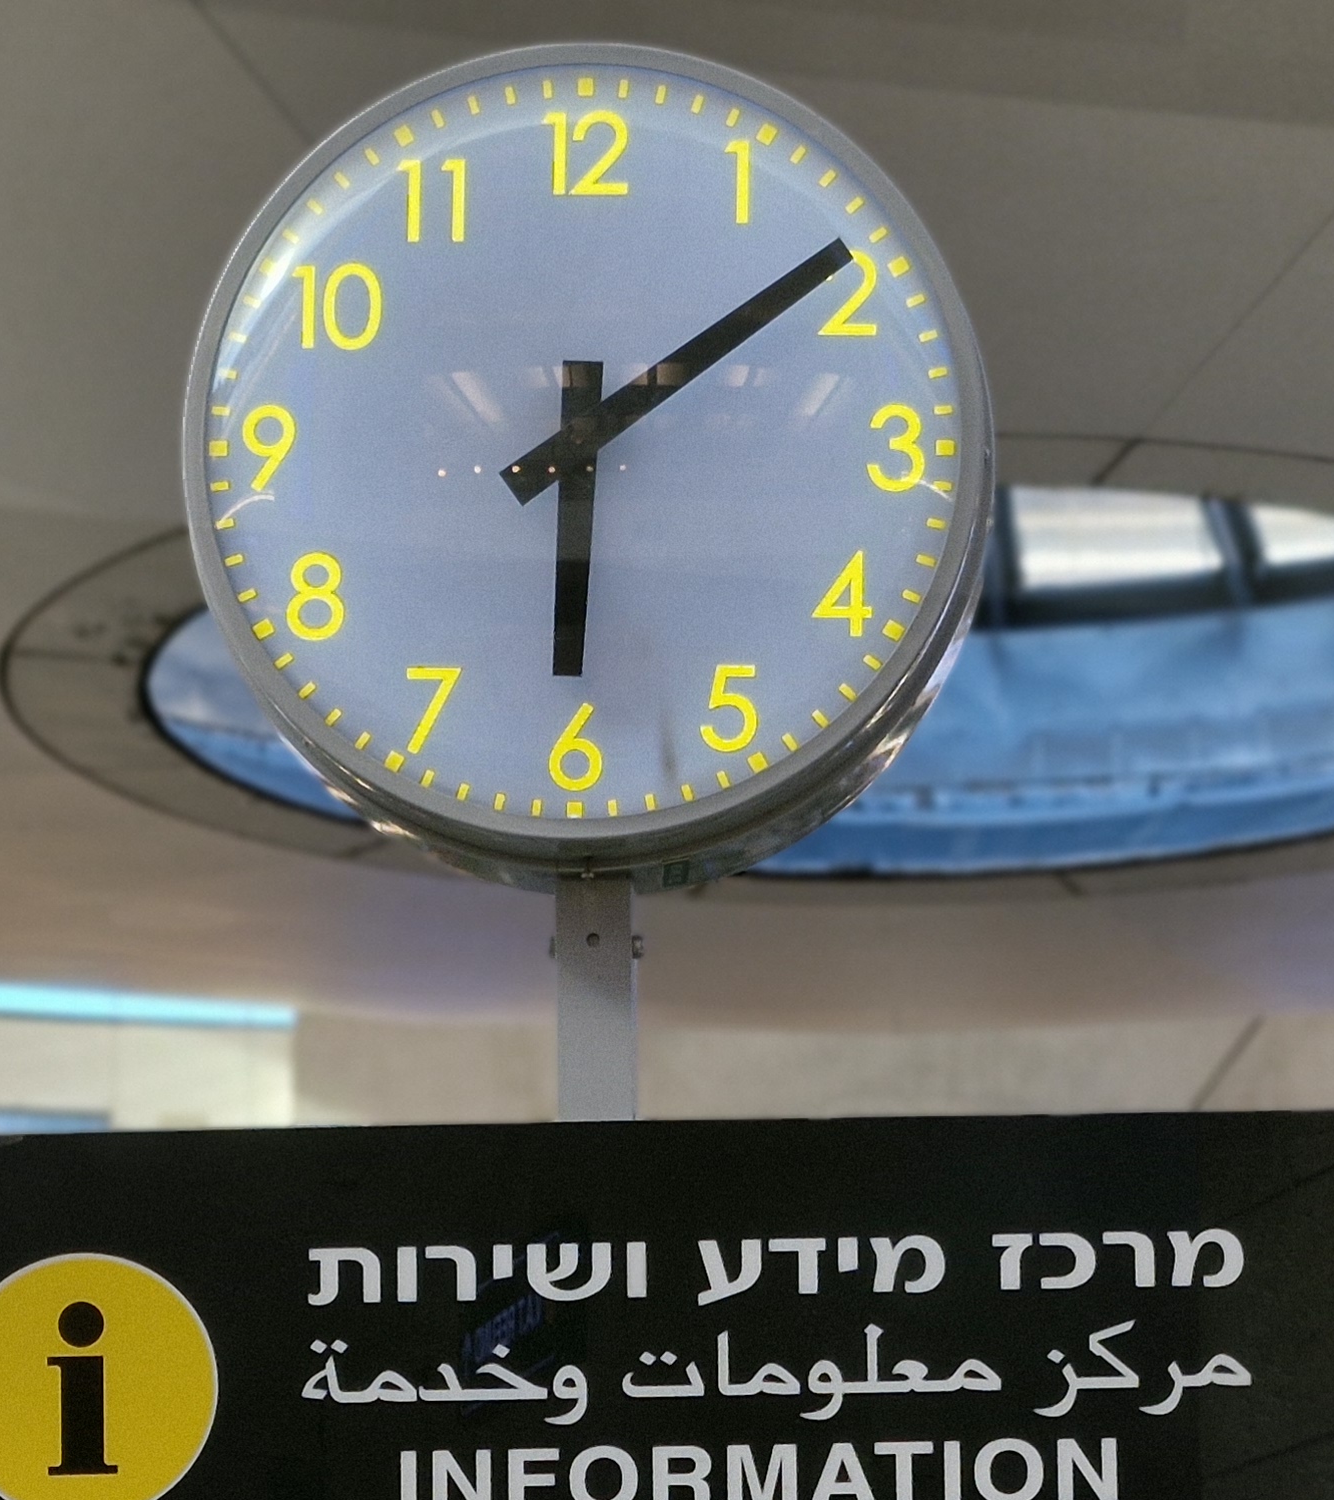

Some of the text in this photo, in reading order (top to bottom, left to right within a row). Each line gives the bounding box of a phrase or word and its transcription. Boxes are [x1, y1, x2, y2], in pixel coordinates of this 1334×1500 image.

[542, 111, 629, 195] 12
[725, 139, 749, 224] 1
[399, 158, 465, 241] 11
[292, 263, 382, 350] 10
[819, 250, 877, 335] 2
[241, 404, 297, 492] 9
[867, 404, 925, 492] 3
[285, 552, 344, 640] 8
[812, 551, 872, 636] 4
[406, 667, 461, 754] 7
[549, 702, 602, 791] 6
[701, 664, 757, 751] 5
[308, 1229, 1244, 1305] מרכז מידע ושירות
[302, 1340, 587, 1424] وخدمة
[622, 1324, 1001, 1420] معلومات
[1034, 1320, 1251, 1417] مركز
